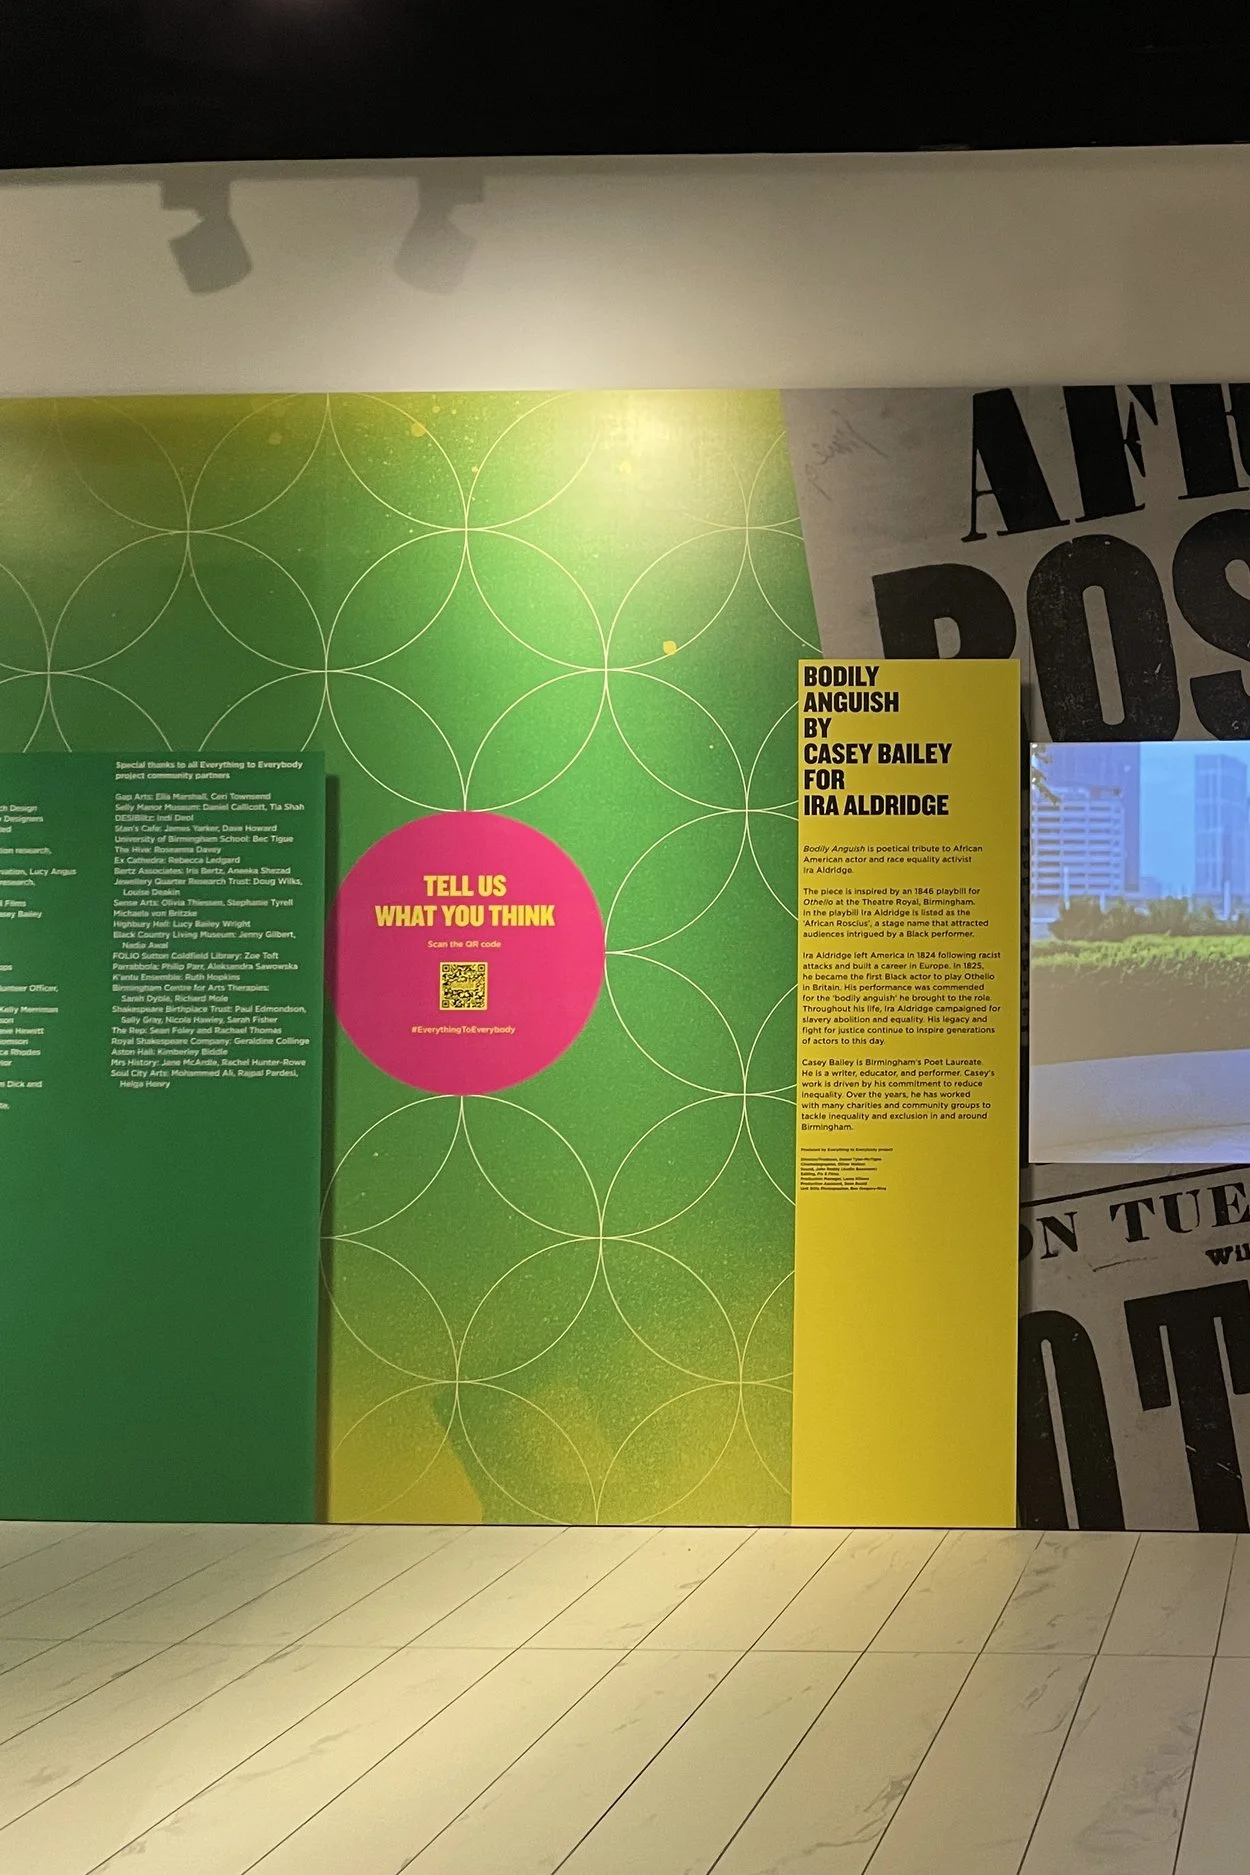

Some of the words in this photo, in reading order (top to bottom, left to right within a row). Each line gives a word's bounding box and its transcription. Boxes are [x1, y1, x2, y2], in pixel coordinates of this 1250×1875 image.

[804, 666, 879, 687] BODILY
[803, 691, 899, 713] ANGUISH
[804, 717, 832, 738] BY
[804, 743, 873, 764] CASEY
[878, 743, 952, 764] BAILEY
[804, 769, 845, 790] FOR
[804, 795, 839, 816] IRA
[844, 795, 949, 816] ALDRIDGE
[803, 845, 830, 853] Bodily
[907, 856, 940, 864] equality
[423, 875, 474, 897] TELL
[478, 874, 507, 897] US
[375, 905, 437, 927] WHAT
[442, 904, 485, 927] YOU
[489, 904, 556, 927] THINK
[427, 940, 448, 949] Scan
[450, 940, 463, 949] the
[465, 940, 479, 949] QR
[480, 940, 502, 949] code
[411, 1025, 516, 1035] #EverythingToEverybody
[802, 1059, 826, 1067] Casey
[829, 1059, 854, 1067] Bailey
[866, 1059, 921, 1067] Birmingham's
